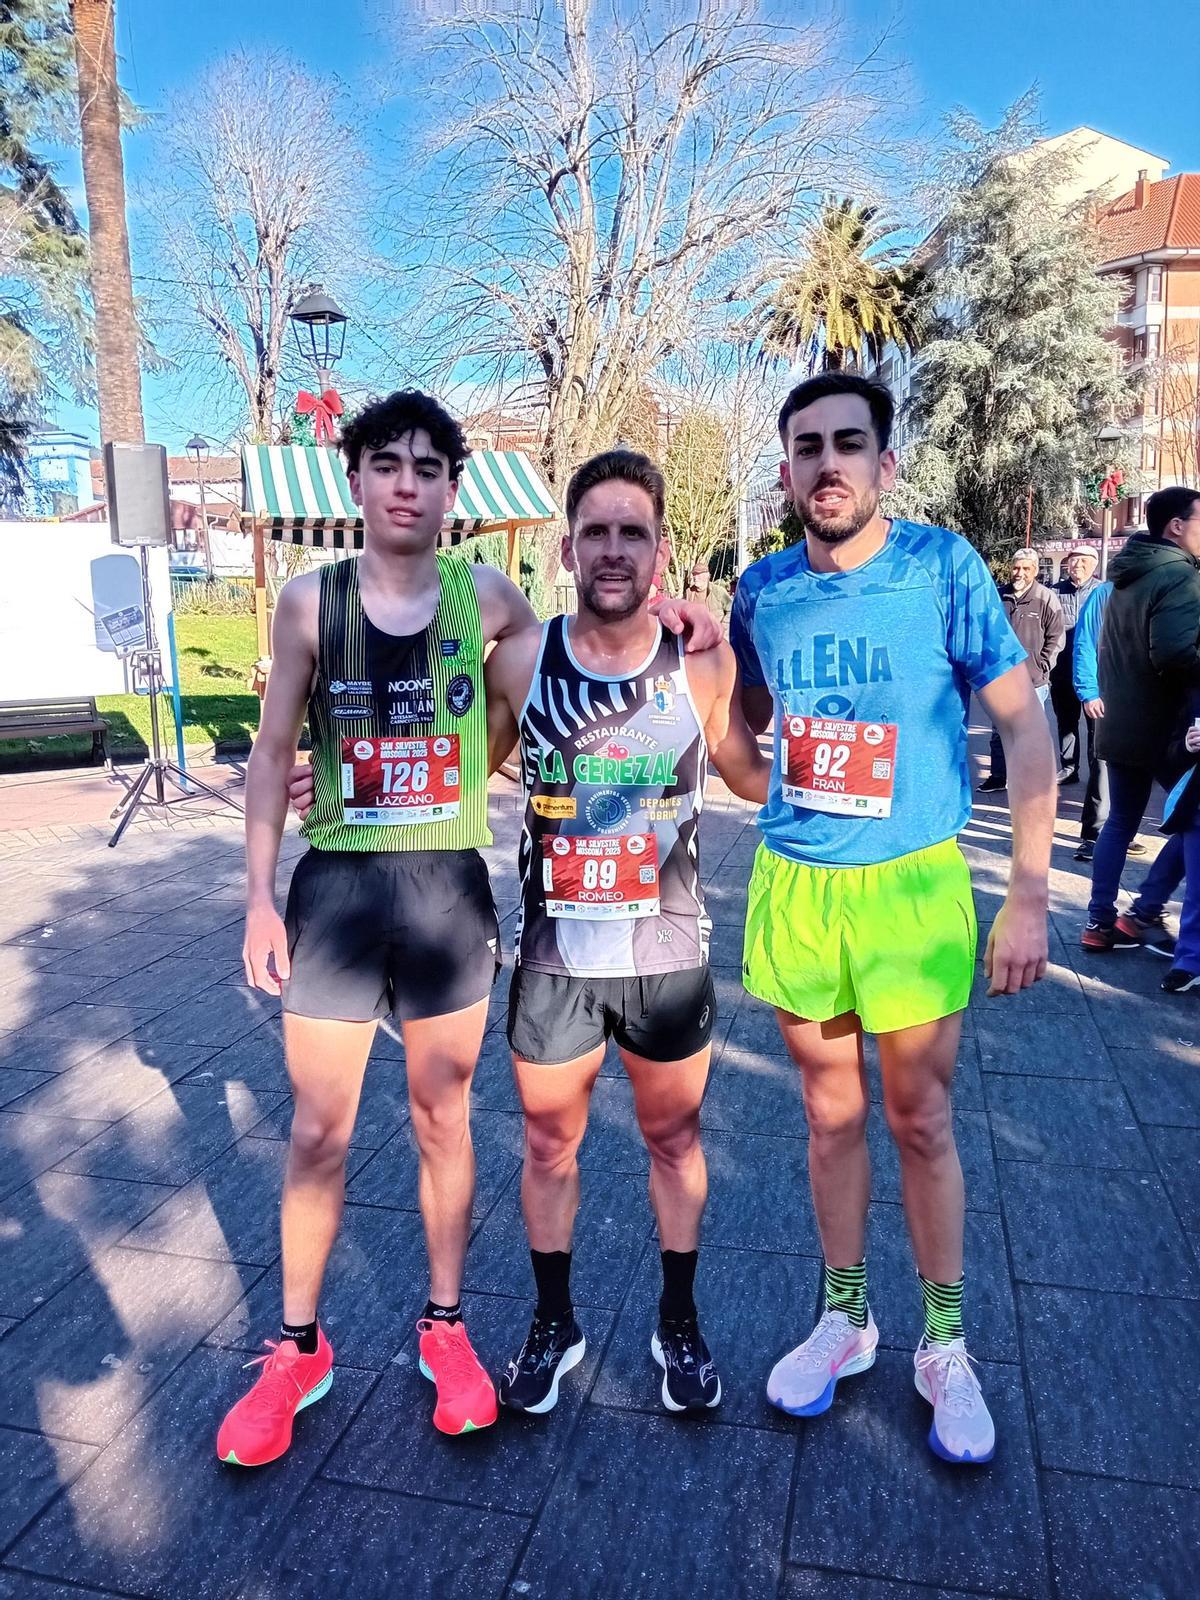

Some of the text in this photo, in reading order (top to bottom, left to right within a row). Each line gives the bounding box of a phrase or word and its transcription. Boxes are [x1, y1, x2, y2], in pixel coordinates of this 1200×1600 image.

[388, 678, 433, 693] NOONE
[388, 697, 435, 715] JULIÁN
[811, 721, 857, 732] SAN SILVESTRE
[574, 726, 658, 750] RESTAURANTE
[380, 741, 427, 750] SAN SILVESTRE
[538, 746, 679, 786] LA CEREZAL
[812, 743, 851, 778] 92
[381, 760, 429, 793] 126
[812, 778, 846, 792] FRAN
[375, 793, 434, 806] LAZCANO
[640, 797, 682, 808] DEPORTES
[575, 839, 620, 847] SAN SILVESTRE
[582, 859, 617, 890] 89
[578, 891, 624, 902] ROMEO
